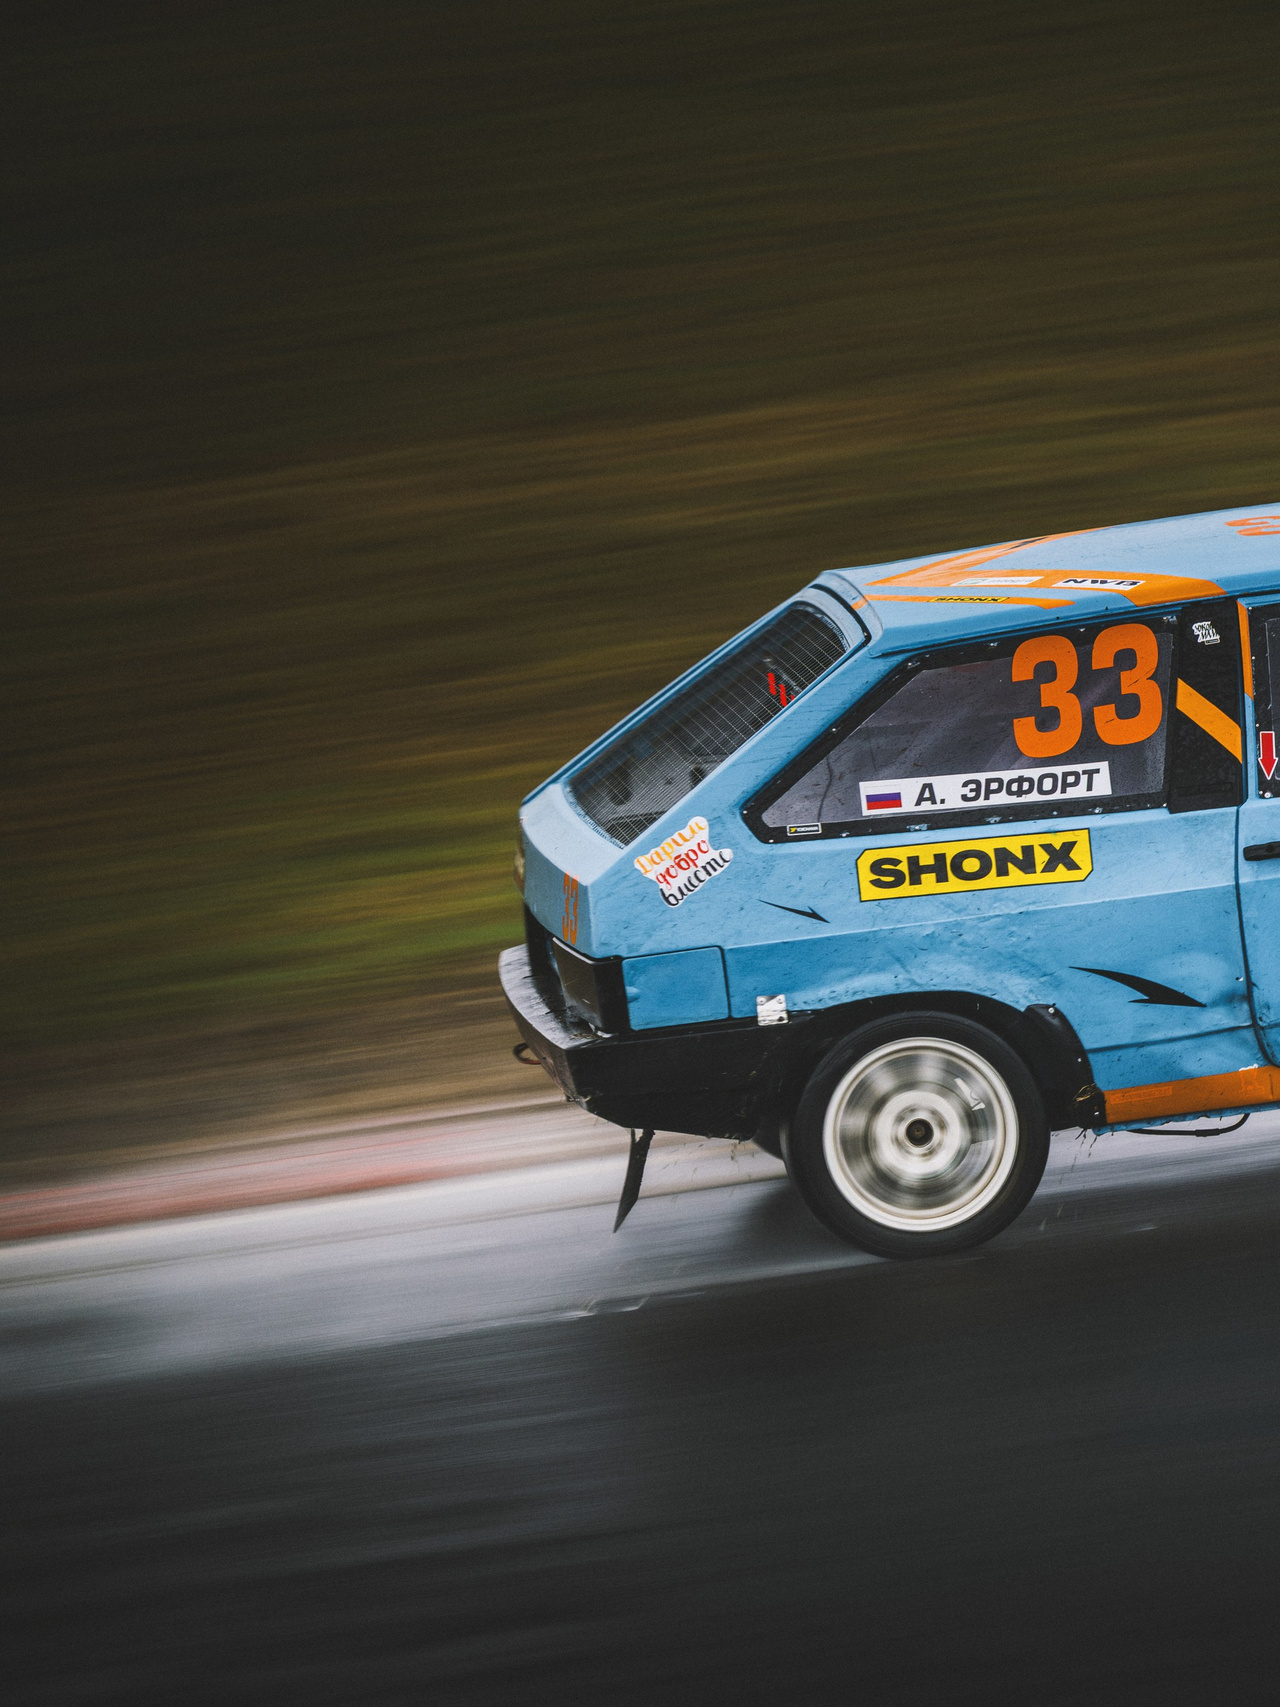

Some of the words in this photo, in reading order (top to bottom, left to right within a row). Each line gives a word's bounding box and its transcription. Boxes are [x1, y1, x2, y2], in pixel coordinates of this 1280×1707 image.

[1012, 623, 1163, 758] 33
[914, 782, 946, 807] А.
[960, 768, 1101, 803] ЭРФОРТ
[636, 821, 708, 875] Дарим
[656, 840, 710, 890] добро
[869, 840, 1082, 889] SHONX
[562, 870, 579, 946] 33
